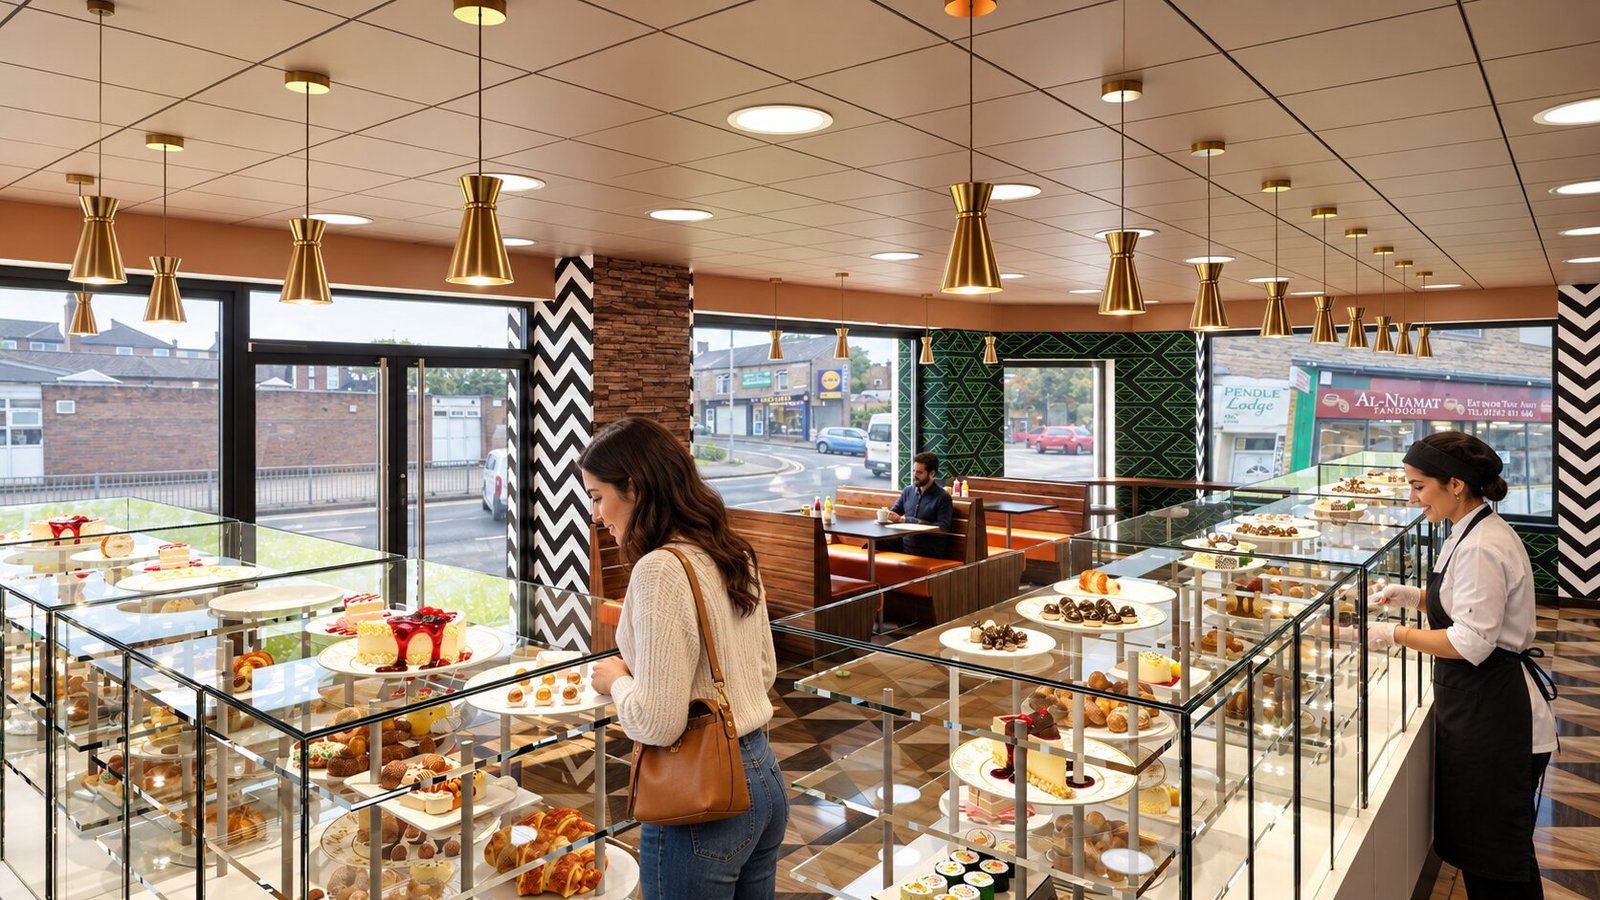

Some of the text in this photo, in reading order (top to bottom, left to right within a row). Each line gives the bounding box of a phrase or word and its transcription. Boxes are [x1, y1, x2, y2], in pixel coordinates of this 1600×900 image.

[1225, 387, 1280, 398] PENDLE
[1355, 392, 1441, 409] AL-NIAMAT
[1225, 397, 1274, 416] Lodge
